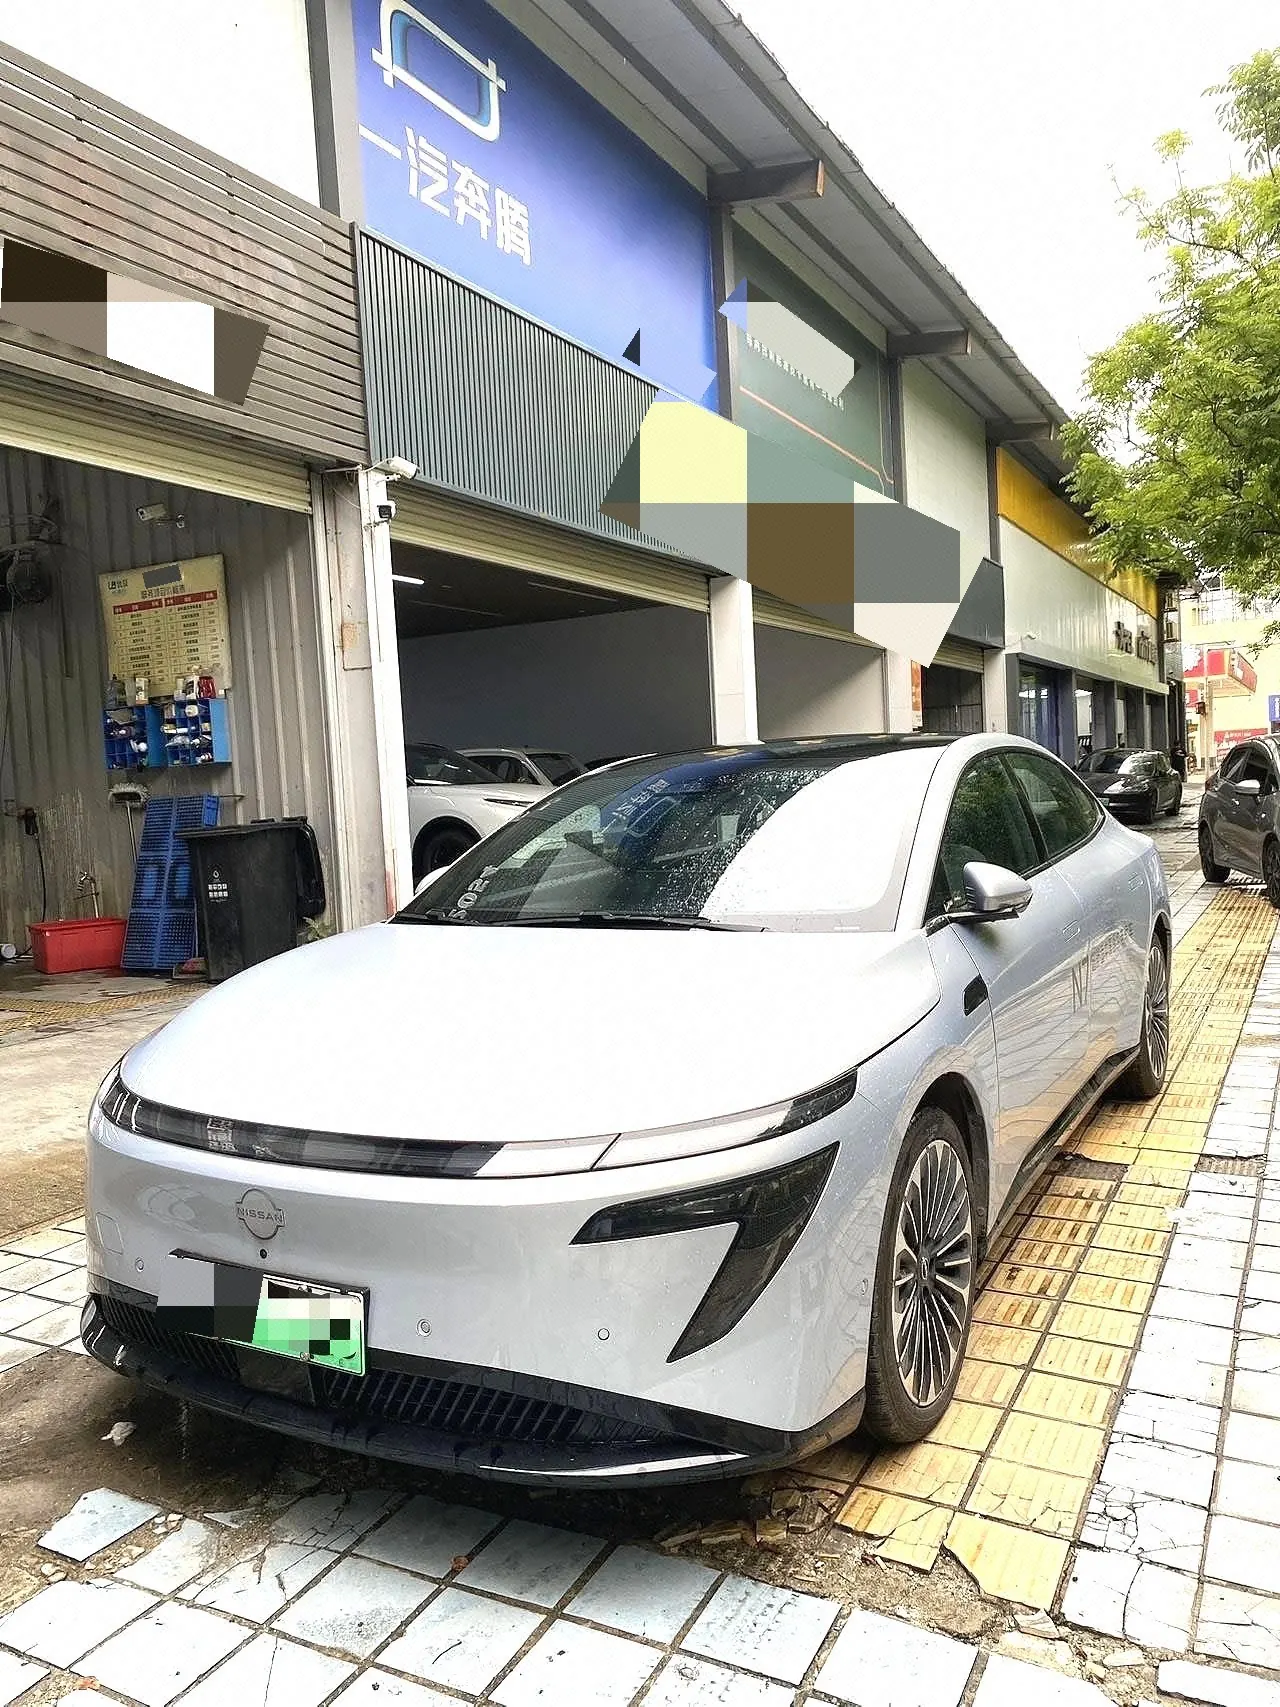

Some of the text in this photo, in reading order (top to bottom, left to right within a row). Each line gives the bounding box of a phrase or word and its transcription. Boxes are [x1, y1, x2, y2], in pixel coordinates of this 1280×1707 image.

[358, 123, 532, 266] 一汽奔腾
[237, 1207, 283, 1223] NISSAN
